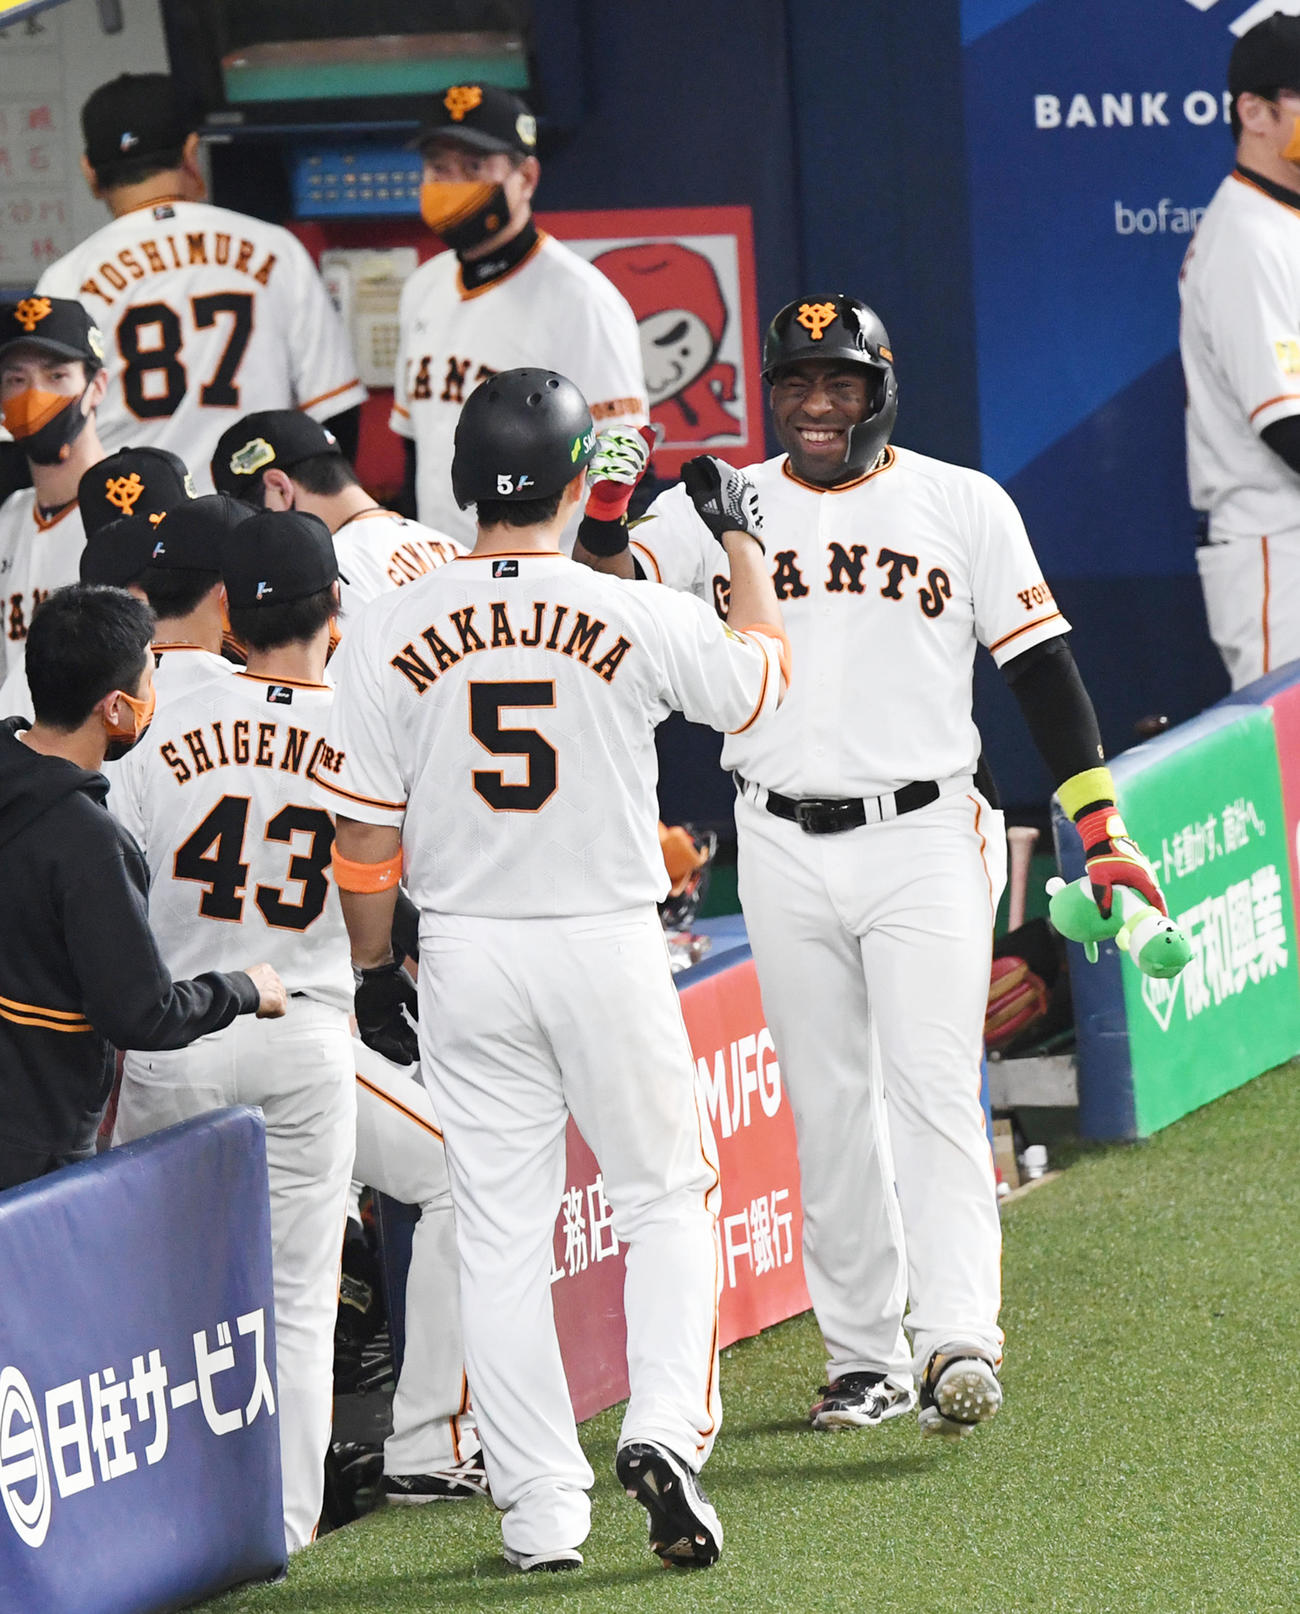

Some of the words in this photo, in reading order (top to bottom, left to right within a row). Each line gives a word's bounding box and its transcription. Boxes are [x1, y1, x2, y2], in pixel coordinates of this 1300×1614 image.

[1034, 92, 1170, 129] BANK
[80, 231, 277, 305] YOSHIMURA
[116, 290, 255, 422] 87
[497, 474, 514, 495] 5
[390, 602, 632, 696] NAKAJIMA
[468, 679, 559, 813] 5
[172, 794, 337, 932] 43
[45, 1308, 276, 1498] 日住サービス
